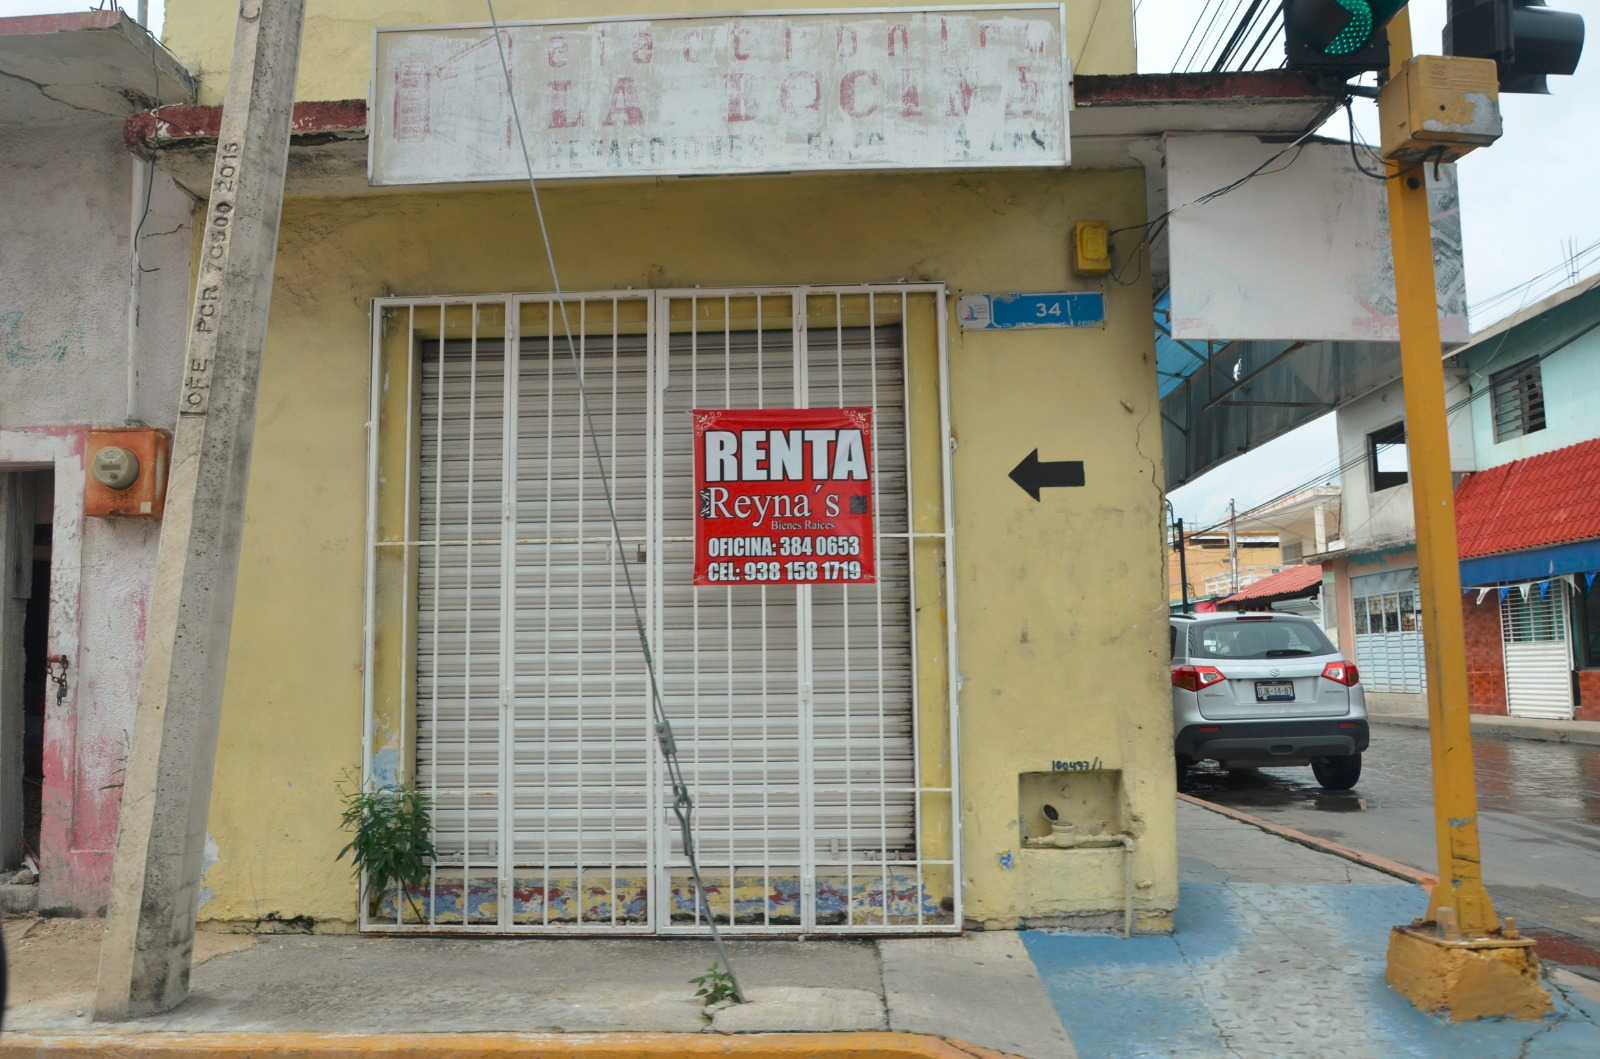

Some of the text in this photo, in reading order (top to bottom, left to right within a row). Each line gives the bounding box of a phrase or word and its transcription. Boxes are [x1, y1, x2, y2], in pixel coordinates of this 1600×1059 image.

[547, 76, 645, 129] LA
[197, 284, 219, 333] PCR
[214, 142, 239, 193] 2015
[1035, 302, 1061, 317] 34
[704, 428, 870, 482] RENTA
[771, 520, 802, 530] Bienes
[708, 535, 860, 557] OFICINA: 384 0653
[708, 560, 862, 582] CEL: 938 158 1719
